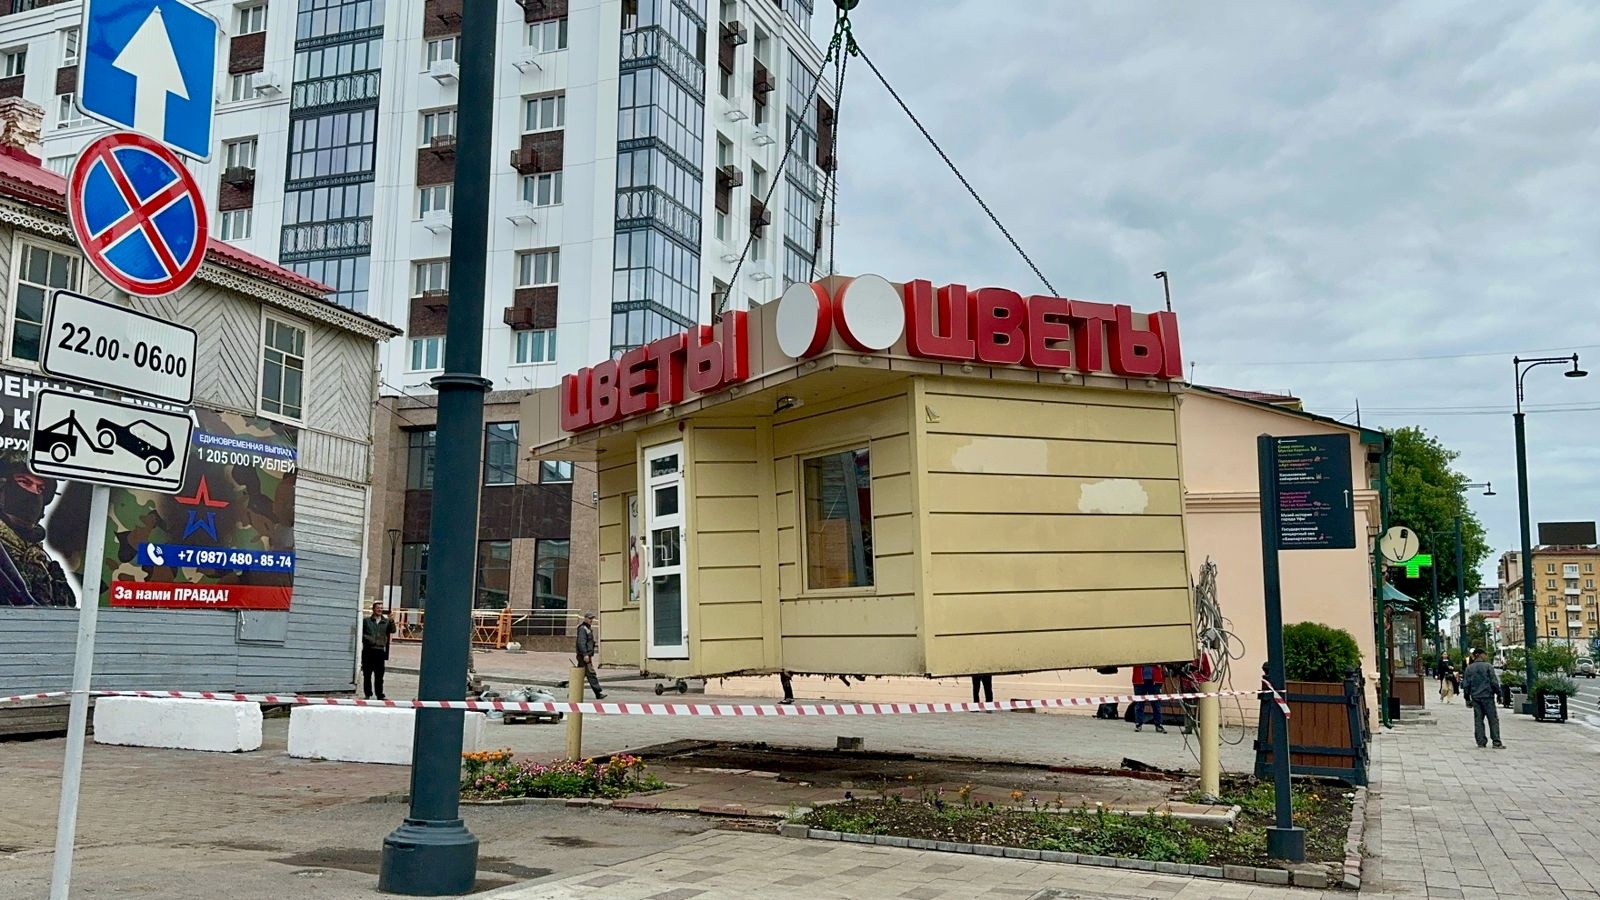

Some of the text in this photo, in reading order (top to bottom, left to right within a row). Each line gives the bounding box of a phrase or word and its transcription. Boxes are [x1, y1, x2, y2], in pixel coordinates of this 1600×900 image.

[905, 279, 1183, 379] ЦВЕТЫ
[561, 310, 748, 432] ЦВЕТЫ
[199, 433, 264, 451] ЕДИНОВРЕМЕННАЯ
[197, 447, 296, 474] 1 205 000 РУБЛЕЙ
[178, 550, 194, 562] +7
[196, 551, 227, 566] (987)
[230, 551, 252, 565] 480
[260, 556, 274, 566] 85
[114, 586, 229, 603] За нами ПРАВДА!
